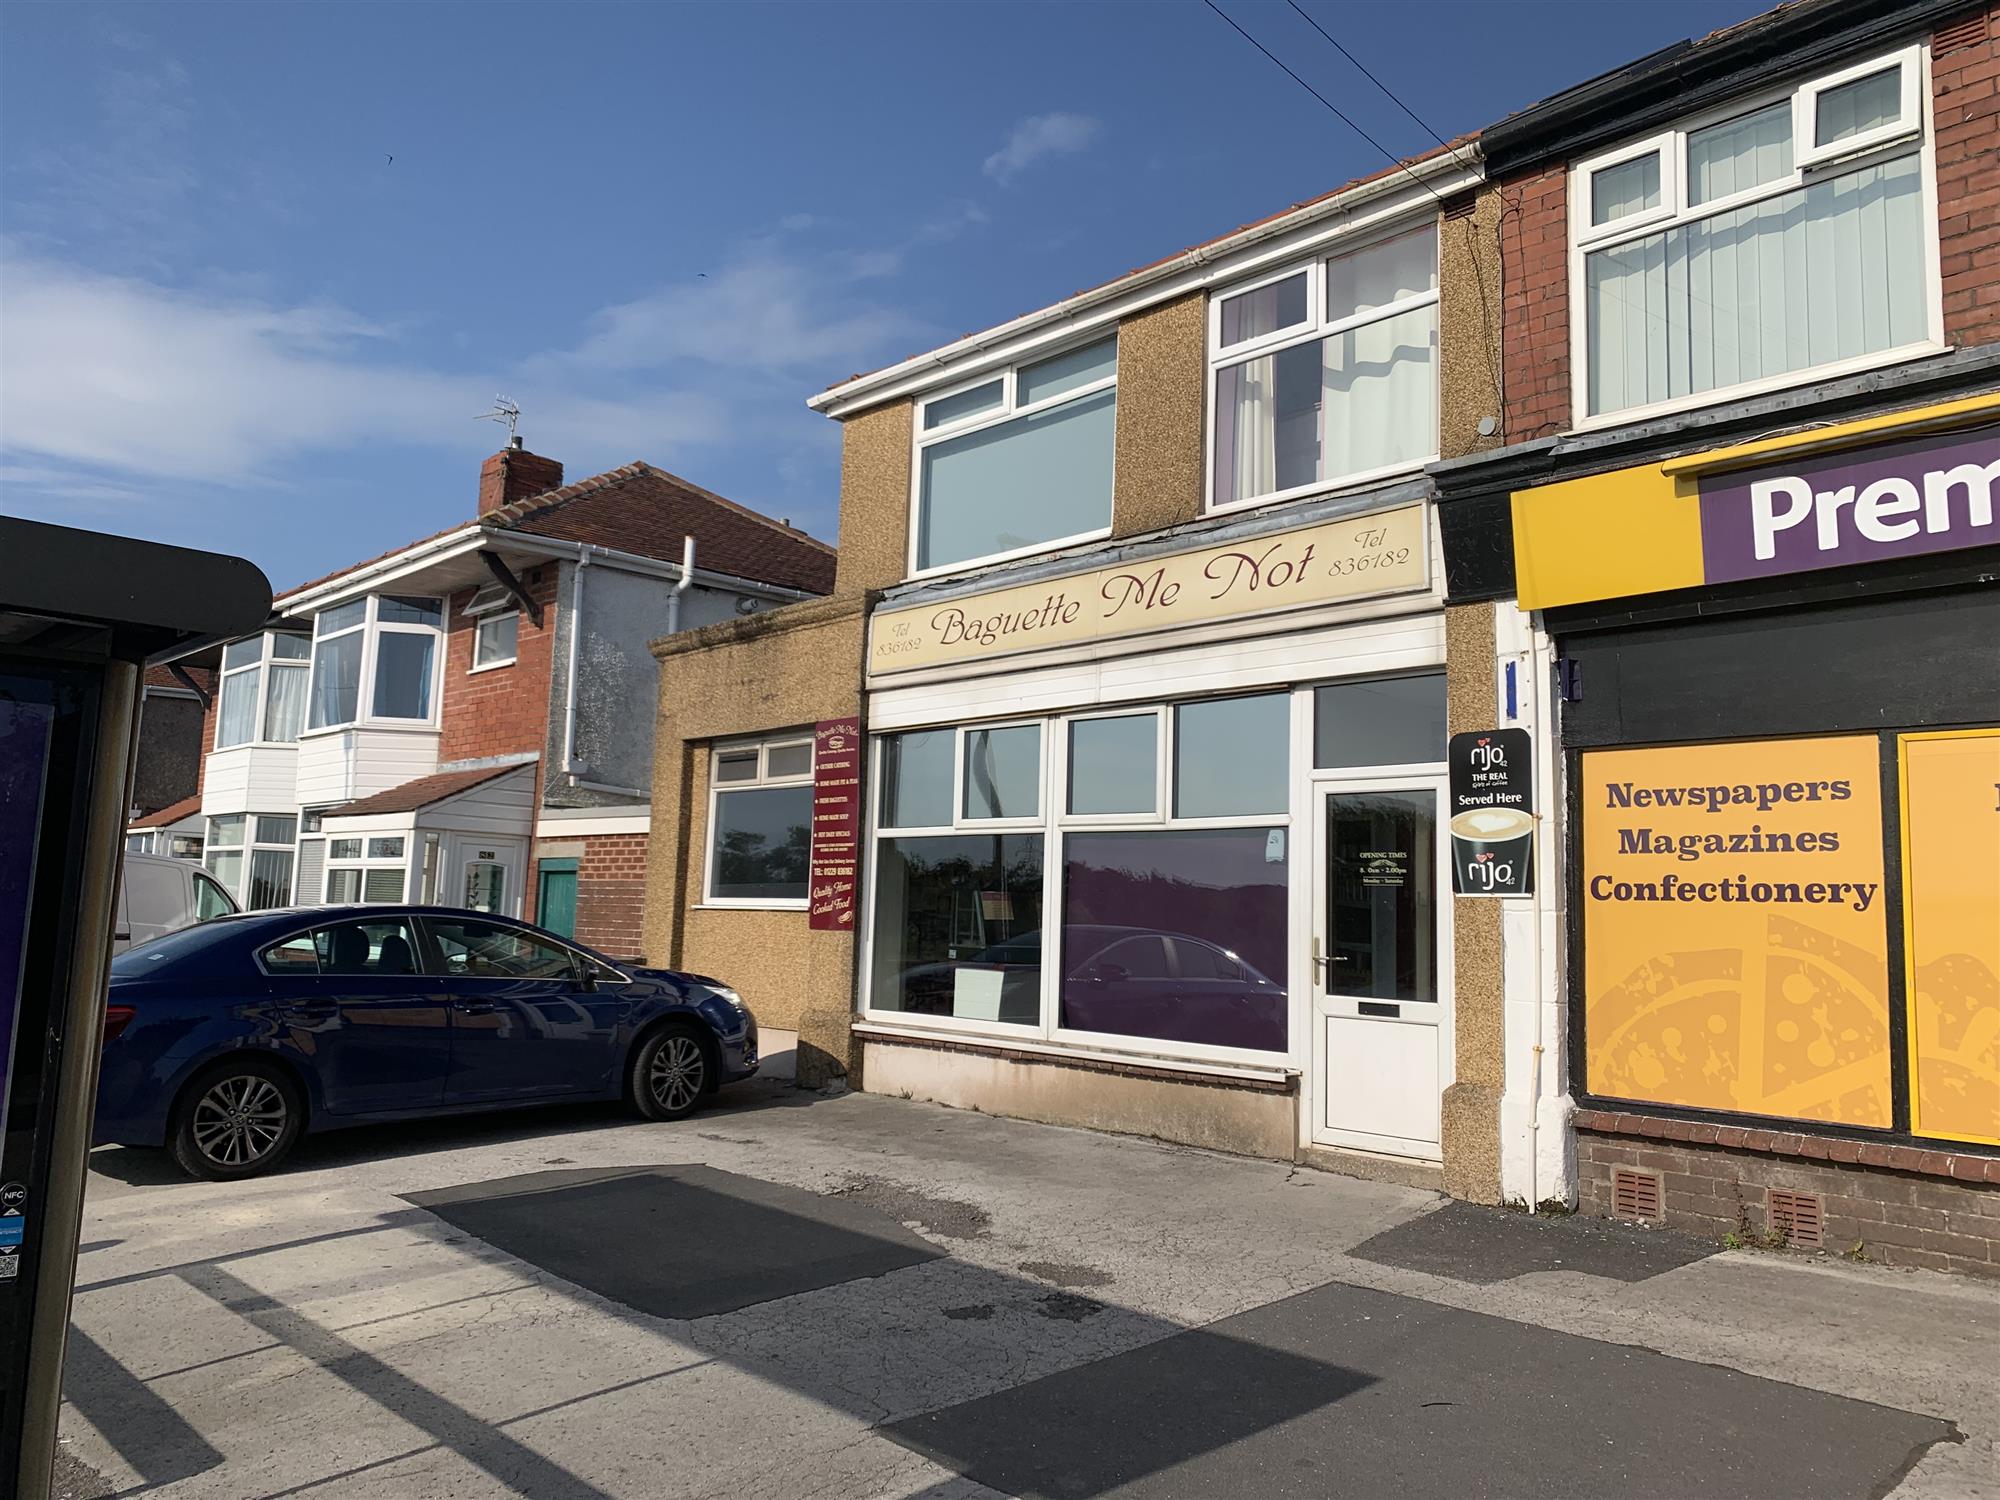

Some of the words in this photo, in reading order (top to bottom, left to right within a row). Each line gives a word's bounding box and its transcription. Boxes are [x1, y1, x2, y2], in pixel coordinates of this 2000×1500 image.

[1751, 458, 2000, 560] Prem
[1354, 528, 1387, 549] Tel
[1328, 547, 1410, 577] 836182
[931, 593, 1081, 646] Baguette
[1101, 567, 1181, 618] Me
[1204, 543, 1316, 600] Not
[892, 622, 911, 637] Tel
[876, 637, 922, 657] 836182
[1472, 773, 1488, 782] THE
[1489, 772, 1509, 781] REAL
[1459, 792, 1493, 805] Served
[1496, 792, 1522, 804] Here
[1606, 780, 1851, 813] Newspapers
[1618, 825, 1840, 861] Magazines
[813, 886, 832, 900] Quality
[833, 881, 852, 894] Home
[1590, 874, 1878, 911] Confectionery
[813, 900, 834, 915] Cooked
[834, 896, 851, 909] Food
[4, 1191, 24, 1200] NFC
